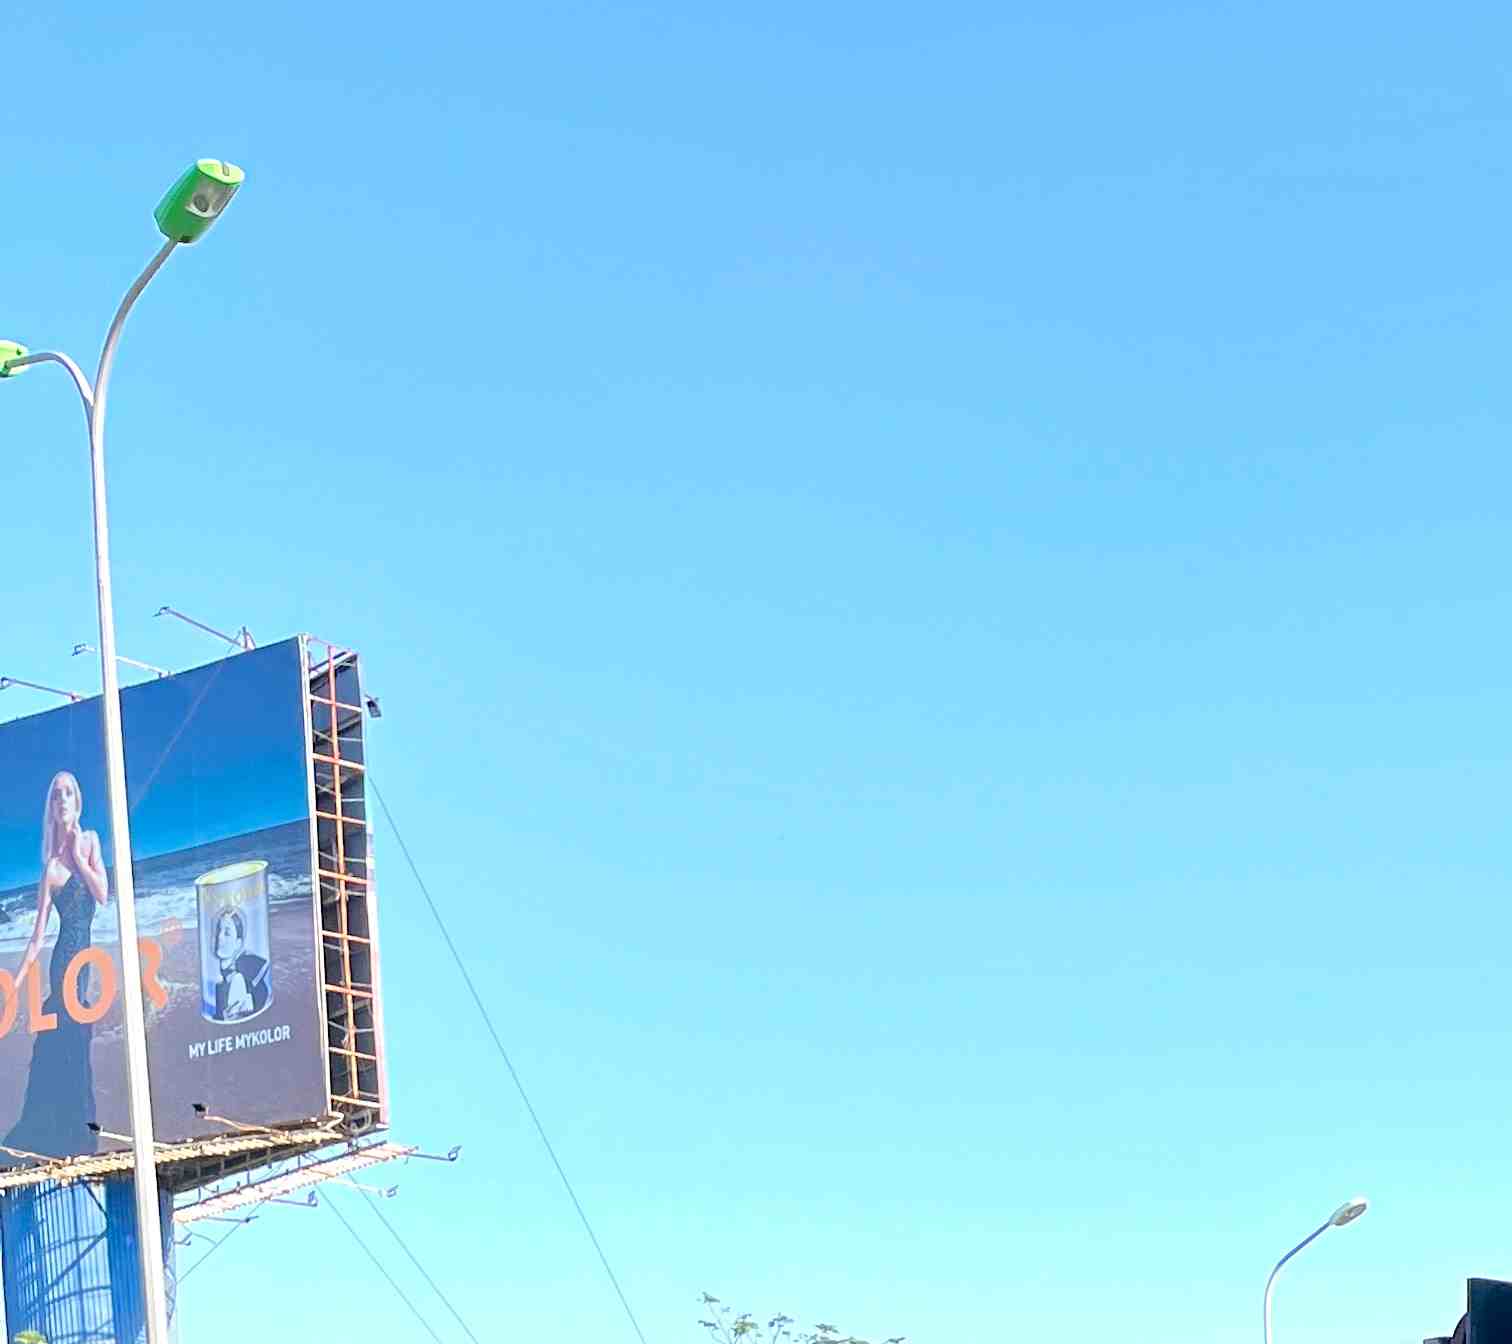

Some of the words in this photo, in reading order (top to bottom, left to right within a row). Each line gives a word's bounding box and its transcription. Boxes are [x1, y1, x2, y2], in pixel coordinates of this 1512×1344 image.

[188, 1042, 205, 1059] MY
[207, 1036, 233, 1055] LIFE
[235, 1024, 291, 1050] MYKOLOR
